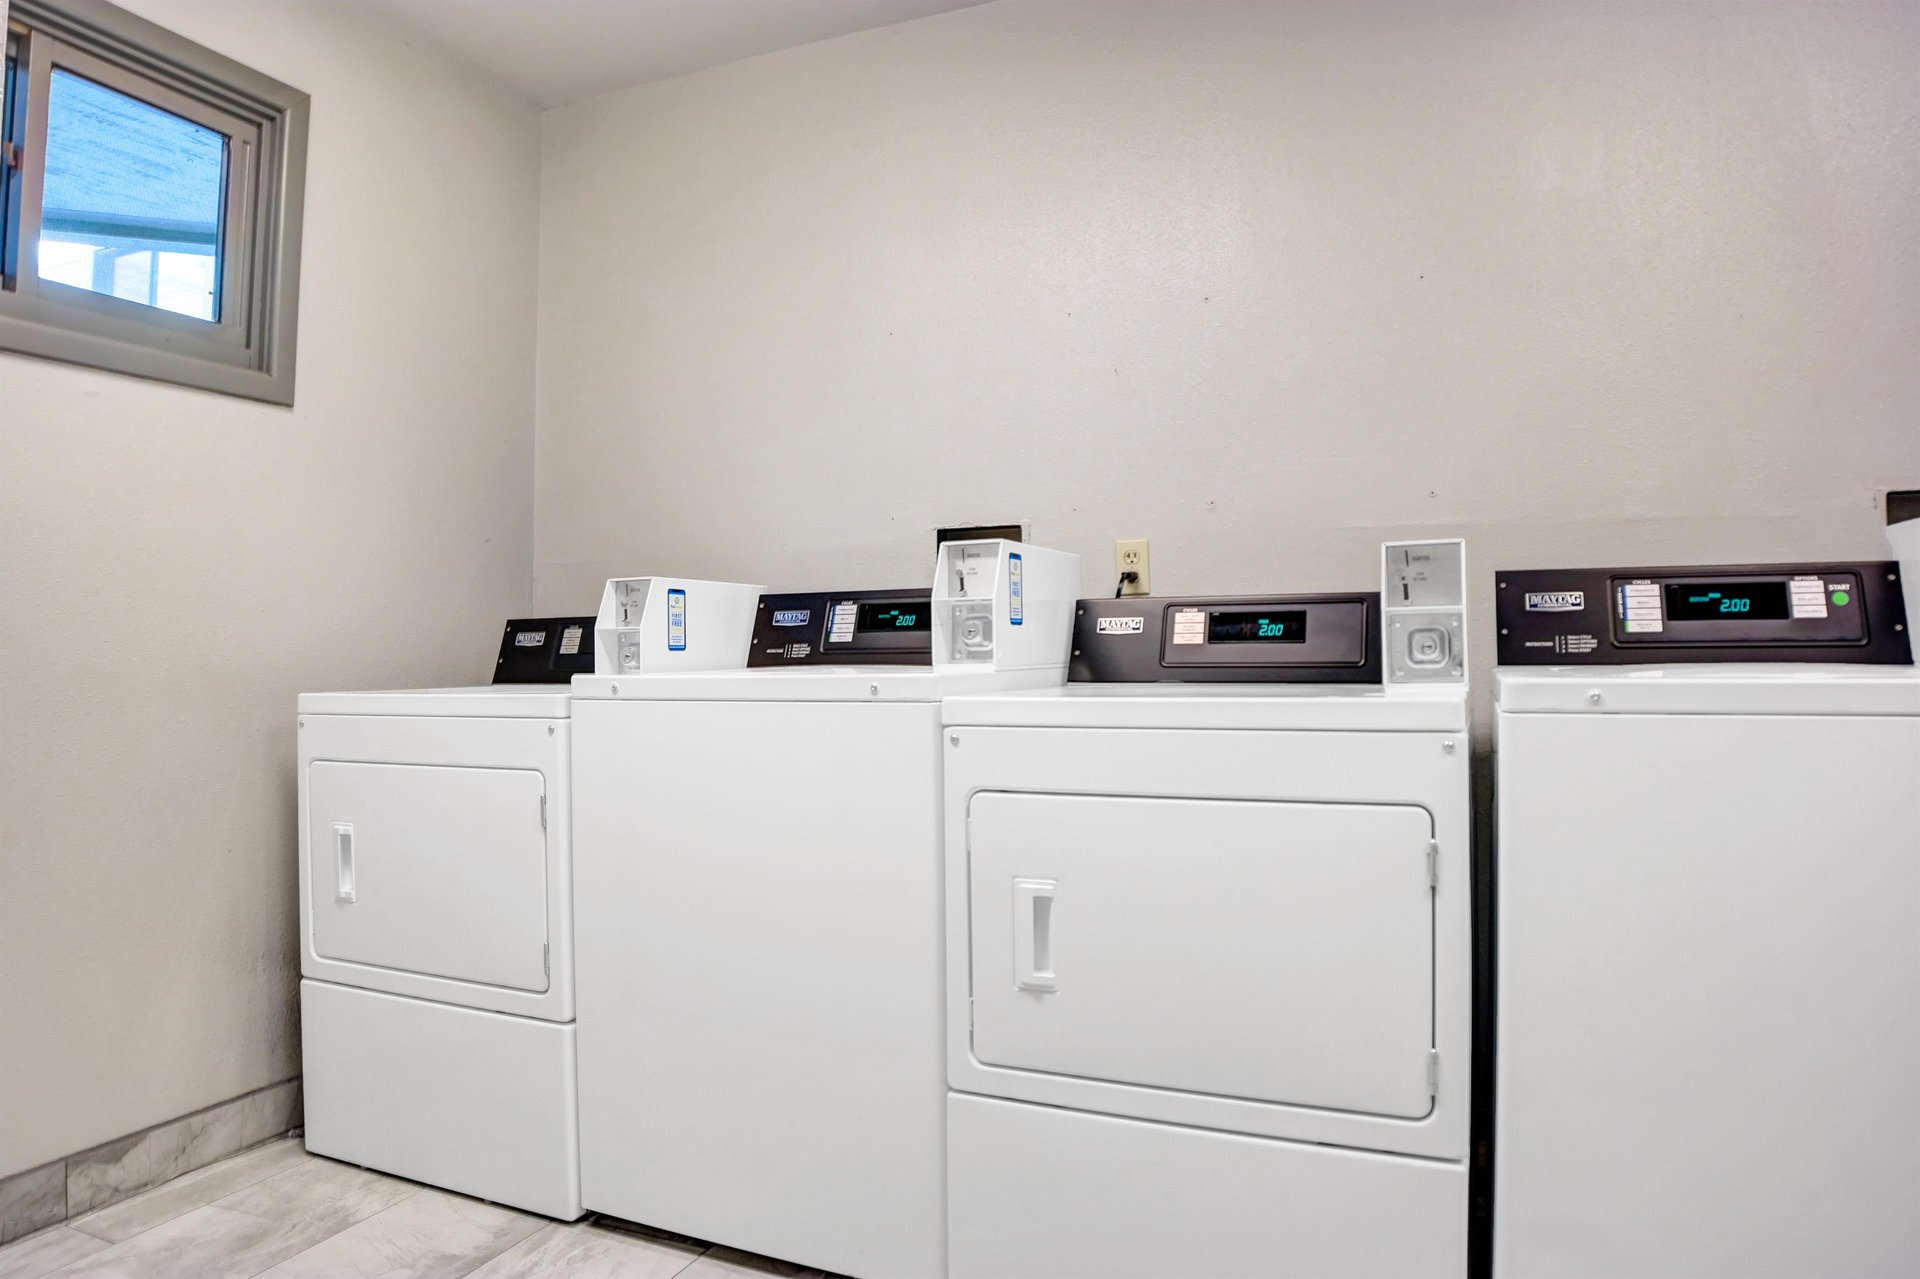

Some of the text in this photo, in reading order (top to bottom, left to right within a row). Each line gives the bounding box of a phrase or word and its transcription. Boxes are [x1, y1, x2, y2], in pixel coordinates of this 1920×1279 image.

[1828, 583, 1851, 591] START
[1530, 594, 1581, 605] MAYTAG
[1719, 598, 1750, 612] 2.00
[775, 612, 807, 621] MAYTAG
[895, 614, 917, 627] 2.00
[1100, 619, 1141, 629] MAYTAG
[1258, 624, 1284, 636] 2.00
[518, 633, 544, 641] MAYTAG
